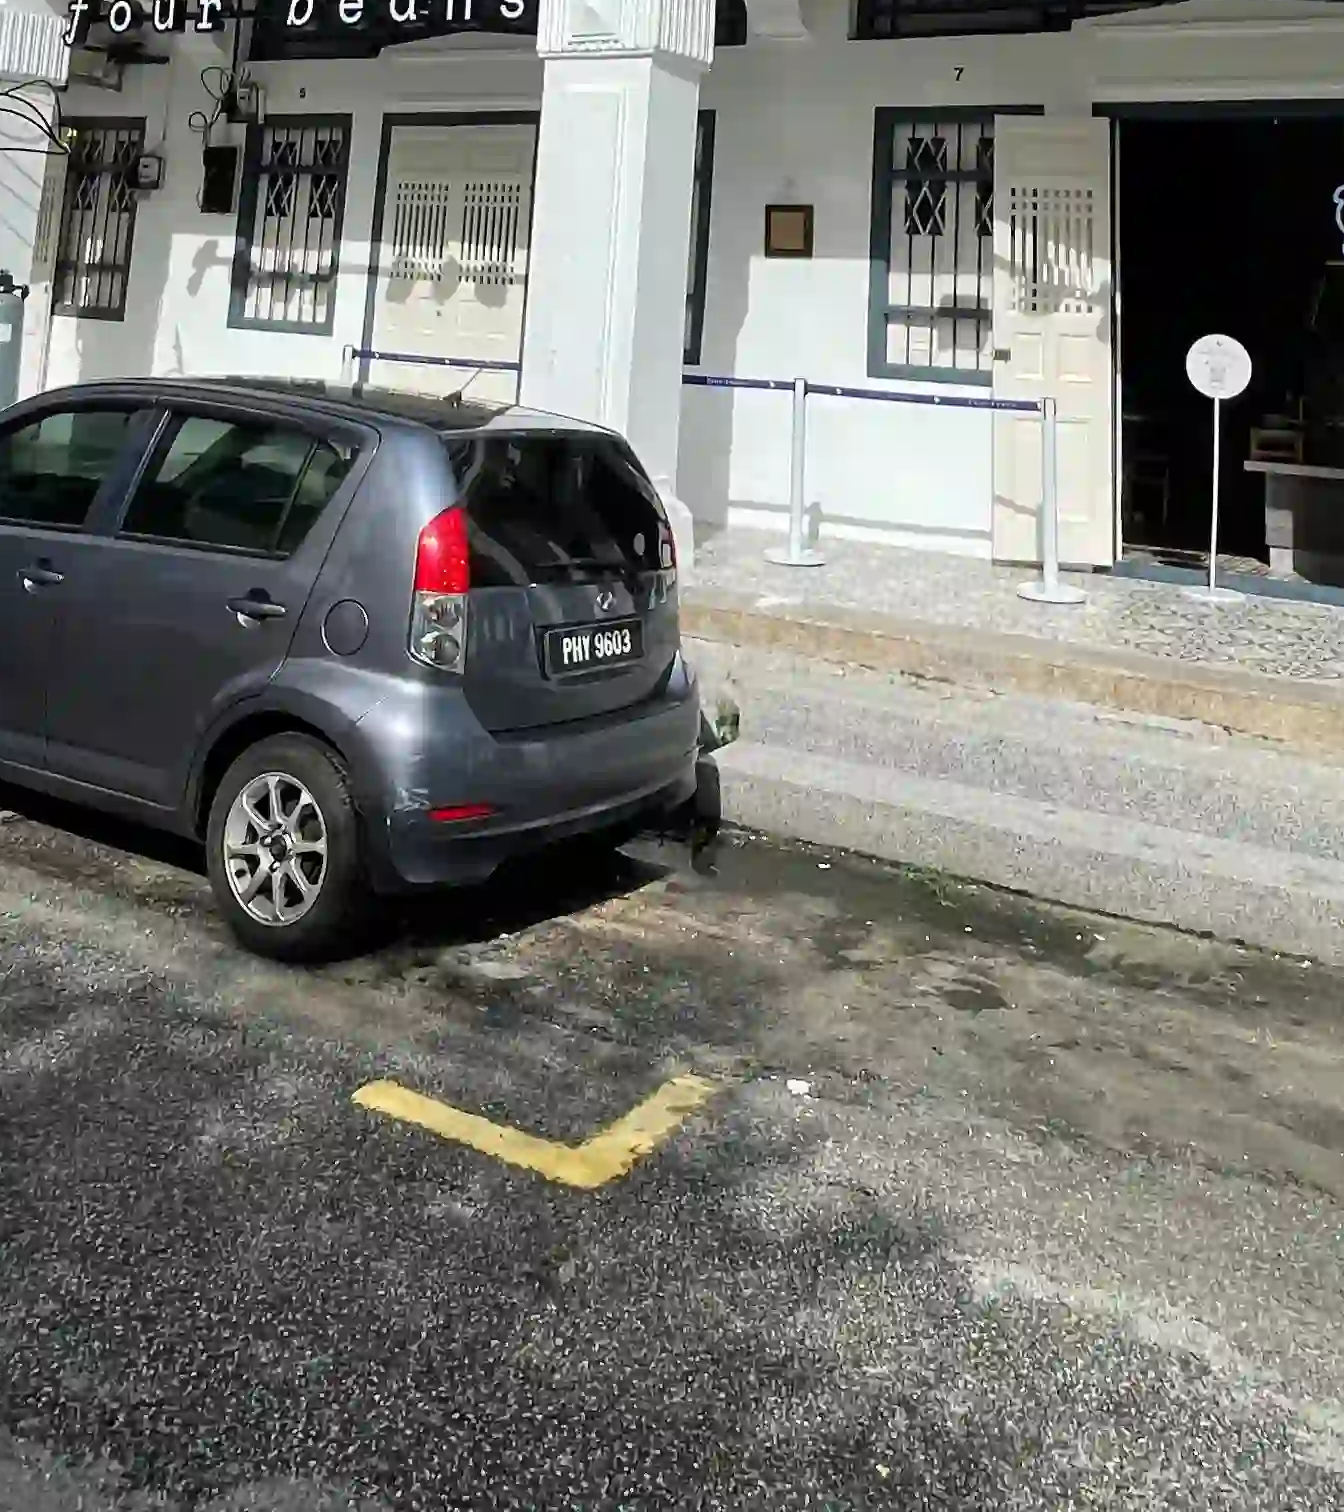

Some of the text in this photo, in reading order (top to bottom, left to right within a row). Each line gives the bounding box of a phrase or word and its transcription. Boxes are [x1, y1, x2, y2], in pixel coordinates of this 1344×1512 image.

[954, 67, 964, 82] 7
[562, 629, 631, 665] PHY 9603
